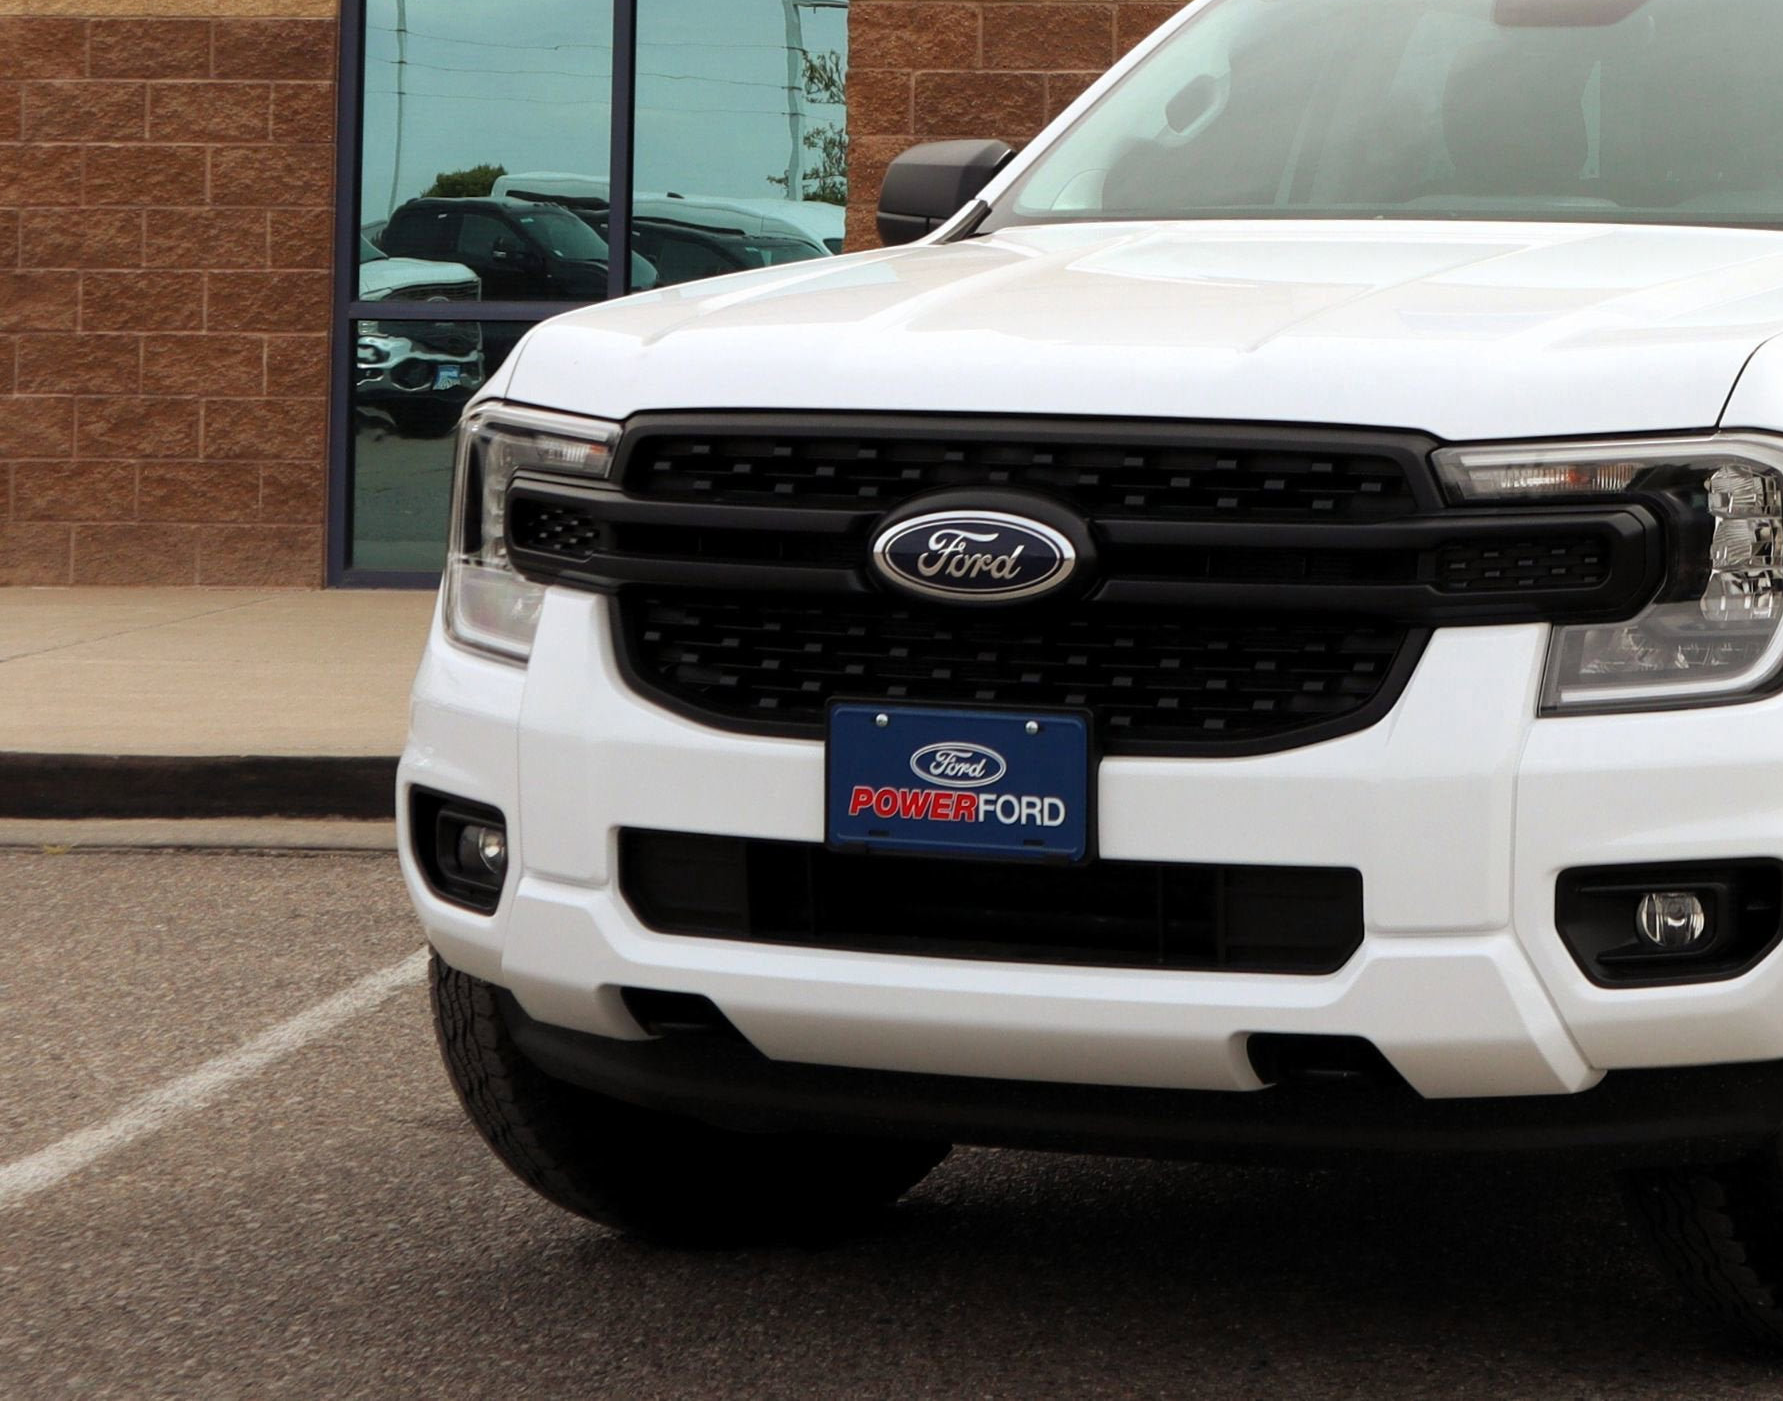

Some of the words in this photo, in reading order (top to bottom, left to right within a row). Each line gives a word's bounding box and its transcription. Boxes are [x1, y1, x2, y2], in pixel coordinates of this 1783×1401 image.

[917, 529, 1024, 580] Ford
[929, 750, 985, 779] Ford
[848, 785, 1065, 828] POWERFORD
